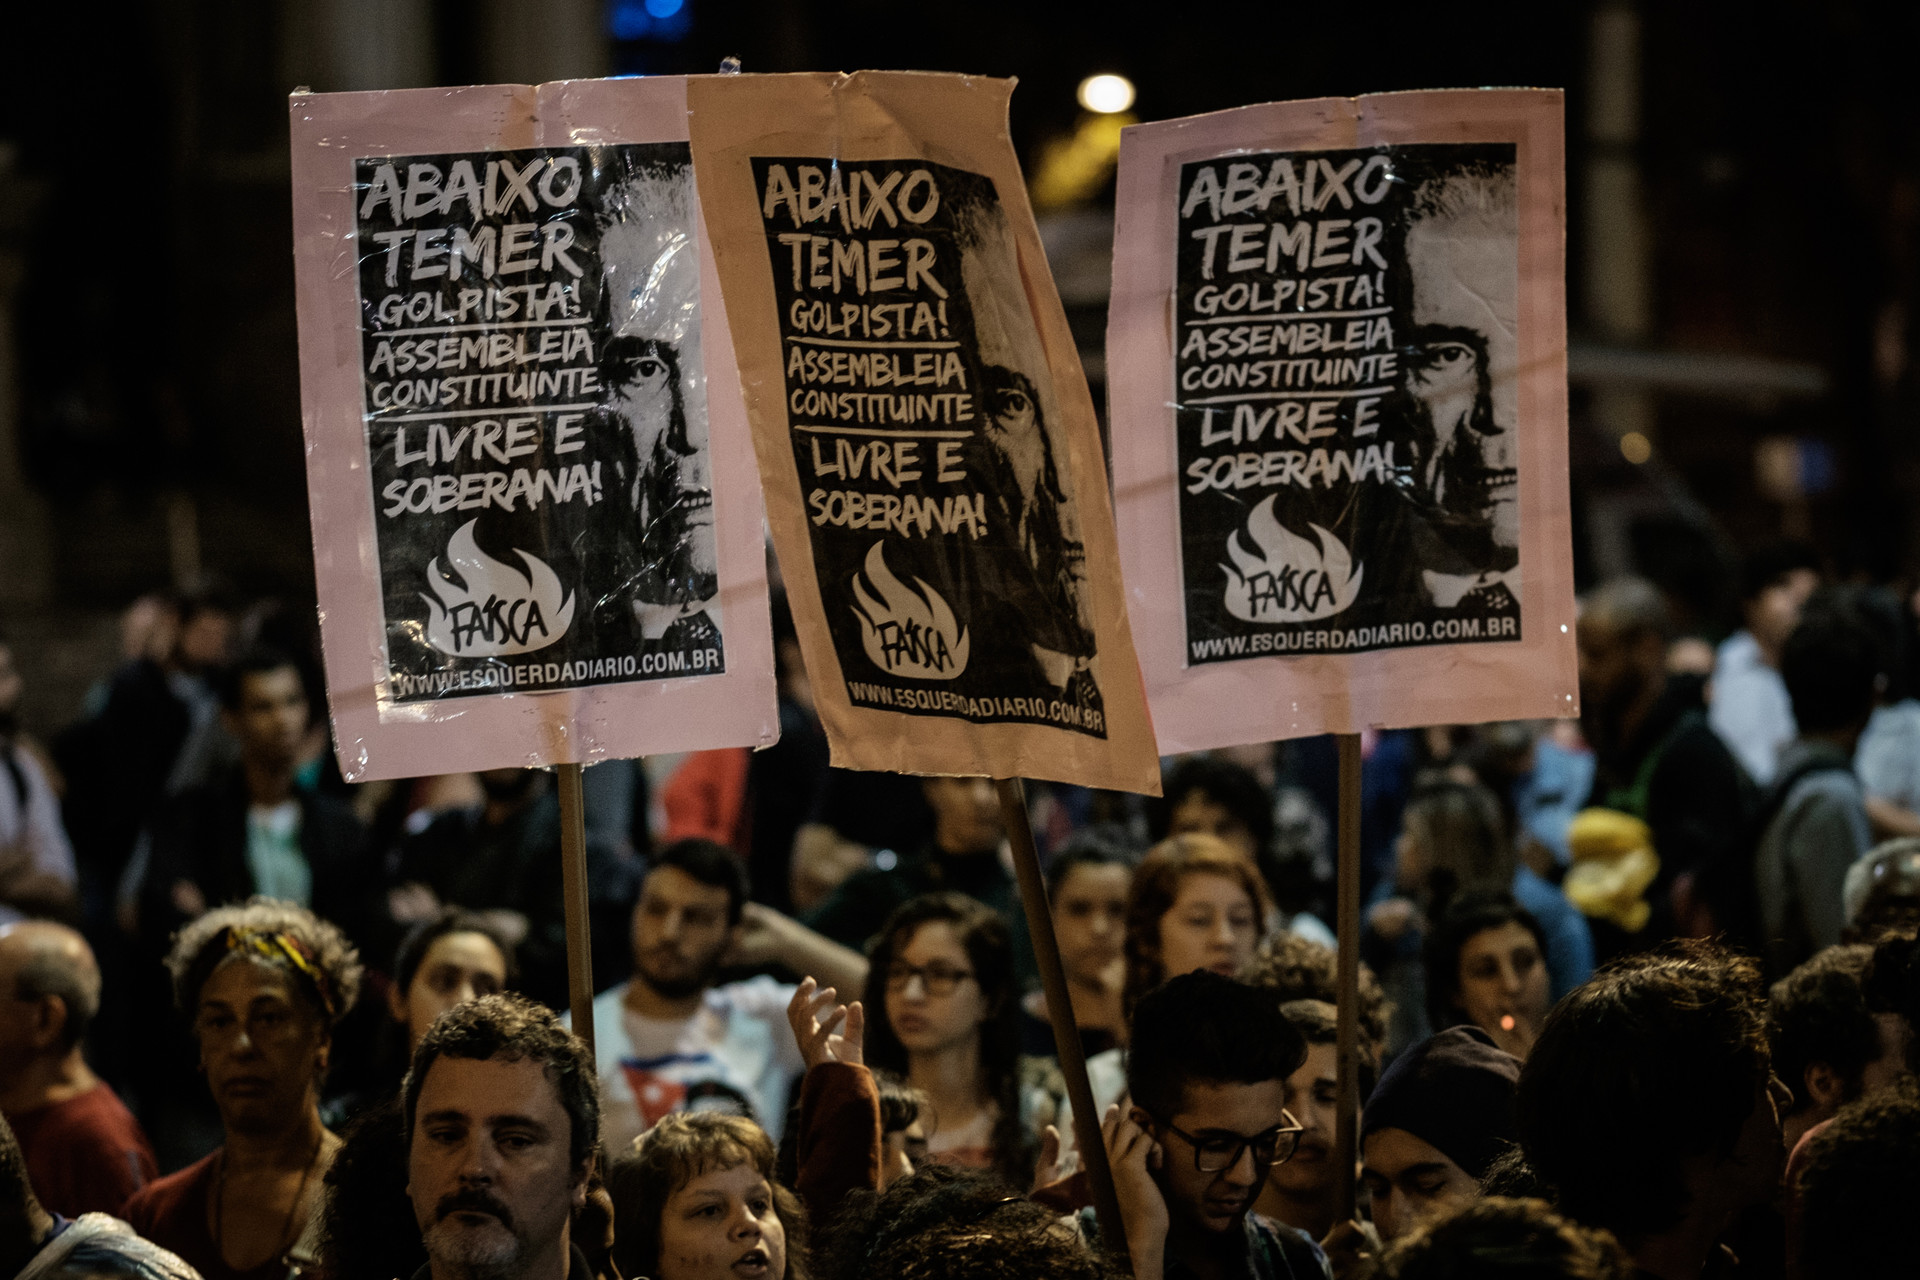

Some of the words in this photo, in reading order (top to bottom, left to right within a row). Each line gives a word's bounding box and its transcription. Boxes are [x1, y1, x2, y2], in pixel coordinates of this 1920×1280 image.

[359, 156, 583, 226] ABAIXO
[763, 163, 940, 235] ABAIXO
[1181, 155, 1392, 222] ABAIXO
[373, 221, 584, 288] TEMER
[778, 233, 949, 300] TEMER
[1191, 217, 1388, 280] TEMER
[379, 278, 582, 327] GOLPISTA!
[1194, 271, 1385, 315] GOLPISTA!
[790, 299, 949, 340] GOLPISTA!
[1181, 317, 1393, 361] ASSEMBLEIA
[369, 328, 594, 377] ASSEMBLEIA
[787, 346, 967, 390] ASSEMBLEIA
[1181, 353, 1398, 390] CONSTITUINTE
[372, 366, 601, 408] CONSTITUINTE
[790, 388, 975, 424] CONSTITUINTE
[395, 416, 540, 467] LIVRE
[554, 414, 586, 455] E
[1200, 400, 1338, 447] LIVRE
[1352, 397, 1381, 438] E
[811, 436, 923, 488] LIVRE
[937, 442, 967, 484] E
[1186, 441, 1395, 495] SOBERANA!
[382, 460, 603, 519] SOBERANA!
[808, 488, 988, 541] SOBERANA!
[1191, 617, 1516, 659] WWW.ESQUERDADIARIO.COM.BR
[398, 648, 720, 696] WWW.ESQUERDADIARIO.COM.BR
[848, 682, 1104, 731] WWW.ESQUERDADIARIO.COM.BR
